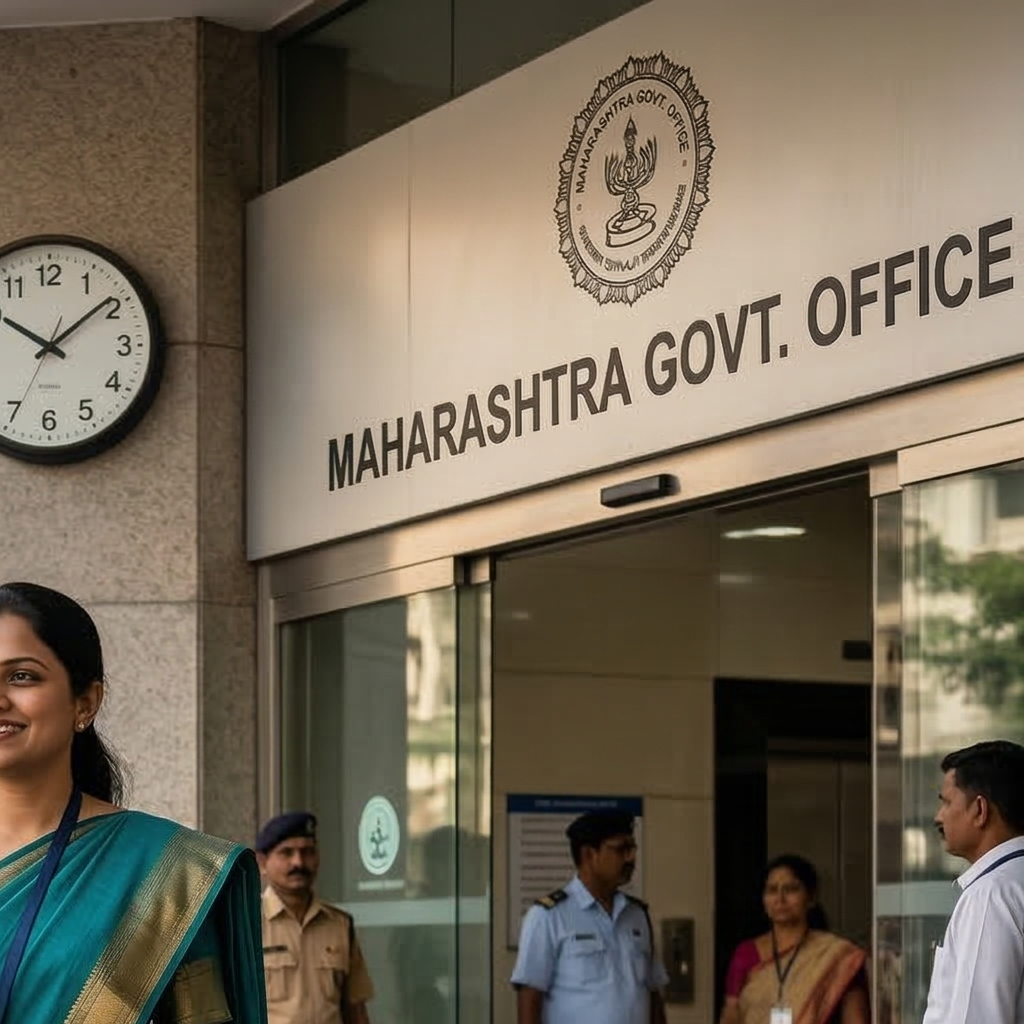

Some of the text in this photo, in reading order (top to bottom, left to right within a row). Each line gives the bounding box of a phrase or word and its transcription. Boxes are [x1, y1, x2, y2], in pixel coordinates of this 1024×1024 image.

[575, 88, 690, 194] MAHARASHTRA GOVT. OFFICE
[35, 263, 62, 287] 12
[81, 271, 90, 295] 1
[3, 275, 23, 299] 11
[104, 298, 121, 320] 2
[116, 334, 132, 357] 3
[328, 346, 632, 491] MAHARASHTRA
[644, 293, 788, 396] GOVT.
[807, 217, 1014, 347] OFFICE
[104, 370, 122, 393] 4
[7, 400, 23, 423] 7
[41, 409, 57, 432] 6
[78, 398, 94, 421] 5
